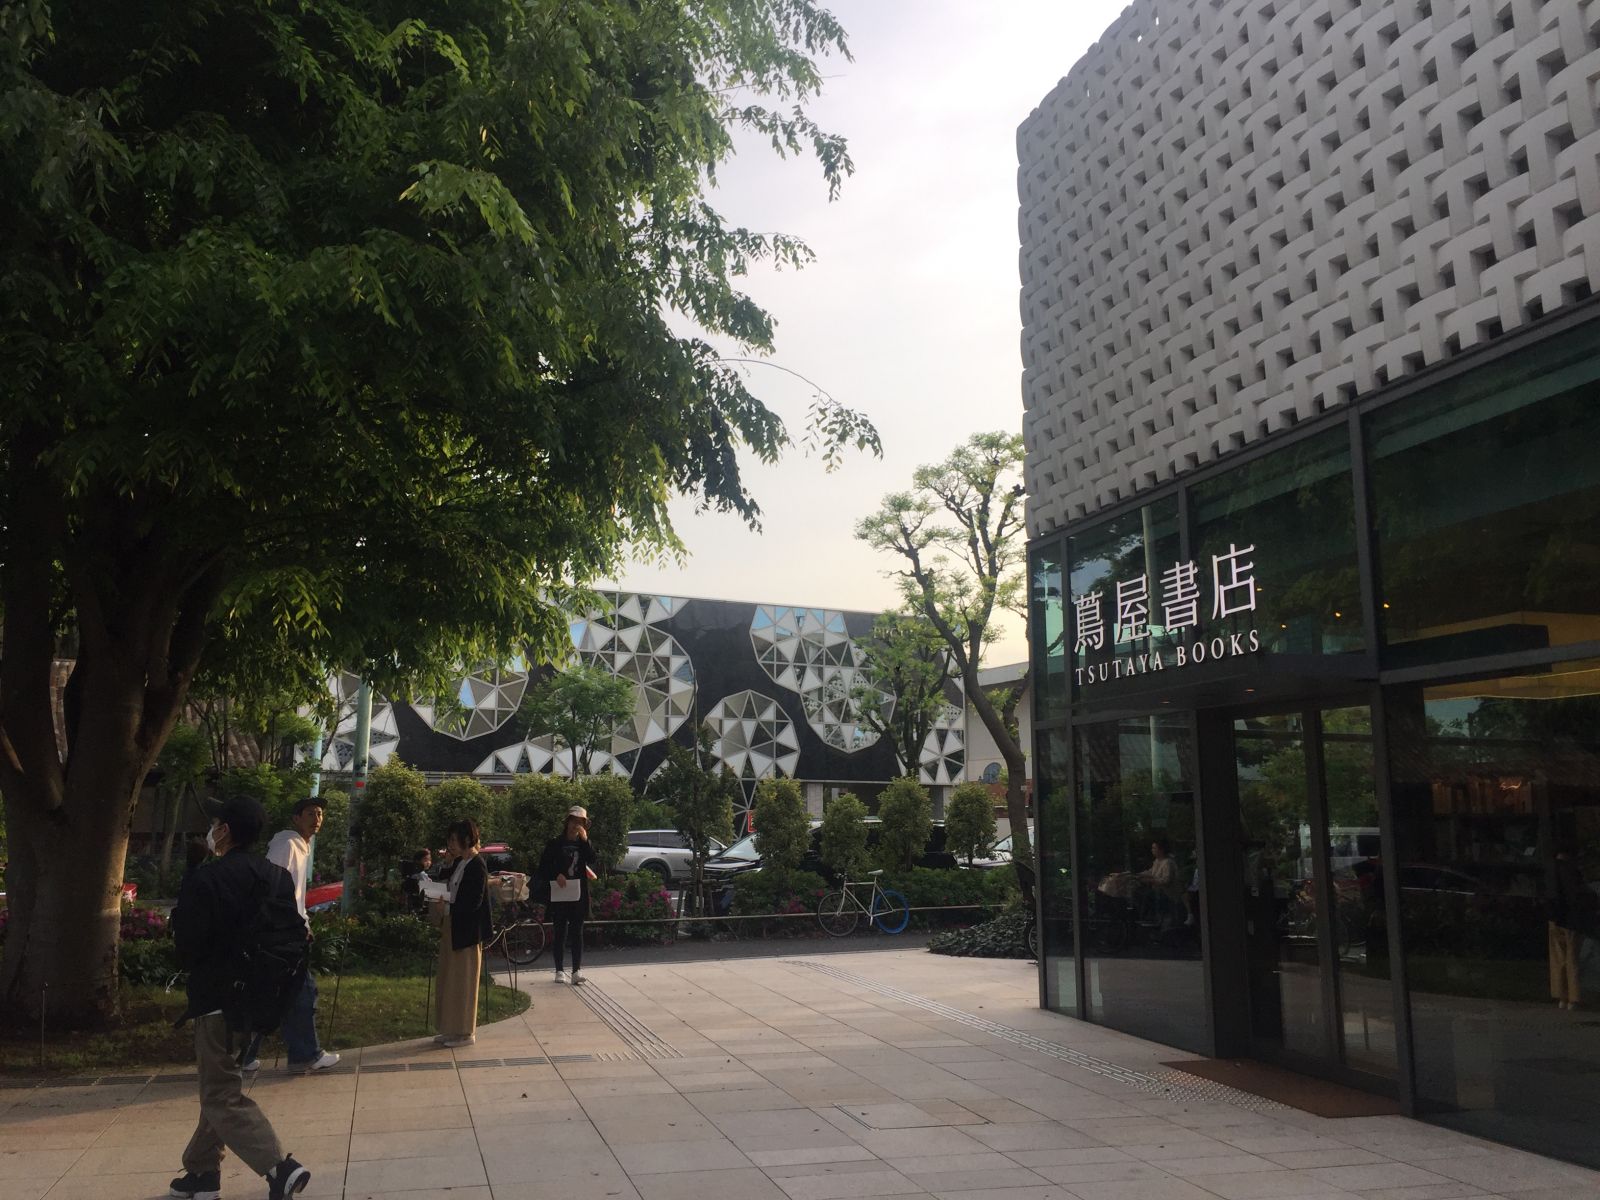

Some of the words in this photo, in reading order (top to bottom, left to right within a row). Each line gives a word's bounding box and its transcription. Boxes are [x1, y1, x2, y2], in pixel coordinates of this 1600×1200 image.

[1073, 543, 1256, 653] 蔦屋書店
[1075, 651, 1164, 686] TSUTAYA
[1176, 629, 1259, 667] BOOKS
